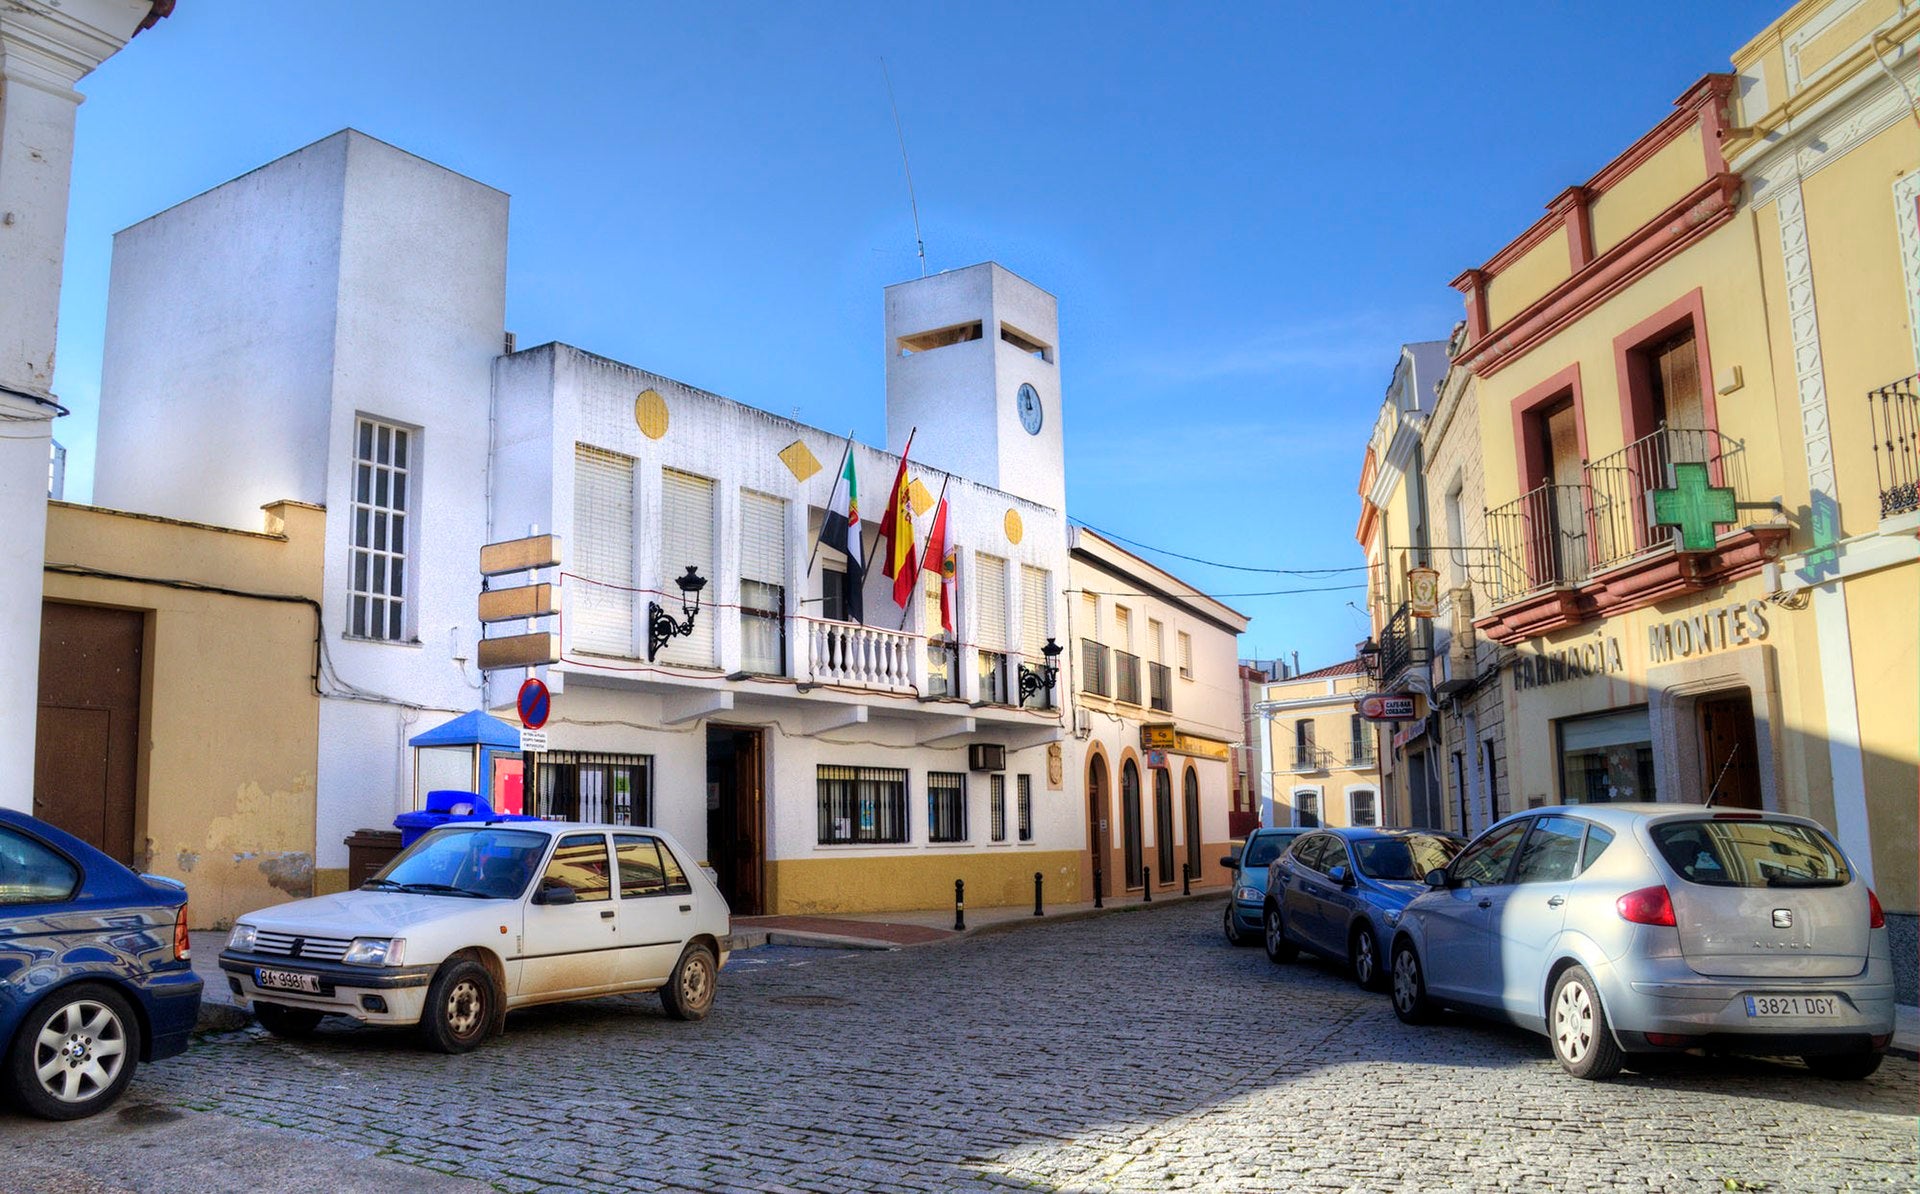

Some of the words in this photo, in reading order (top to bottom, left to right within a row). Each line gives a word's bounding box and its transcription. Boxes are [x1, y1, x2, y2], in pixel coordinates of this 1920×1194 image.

[1648, 598, 1768, 662] MONTES
[1752, 941, 1812, 950] ALTEA
[1758, 998, 1799, 1015] 3821
[1804, 998, 1834, 1015] DGY
